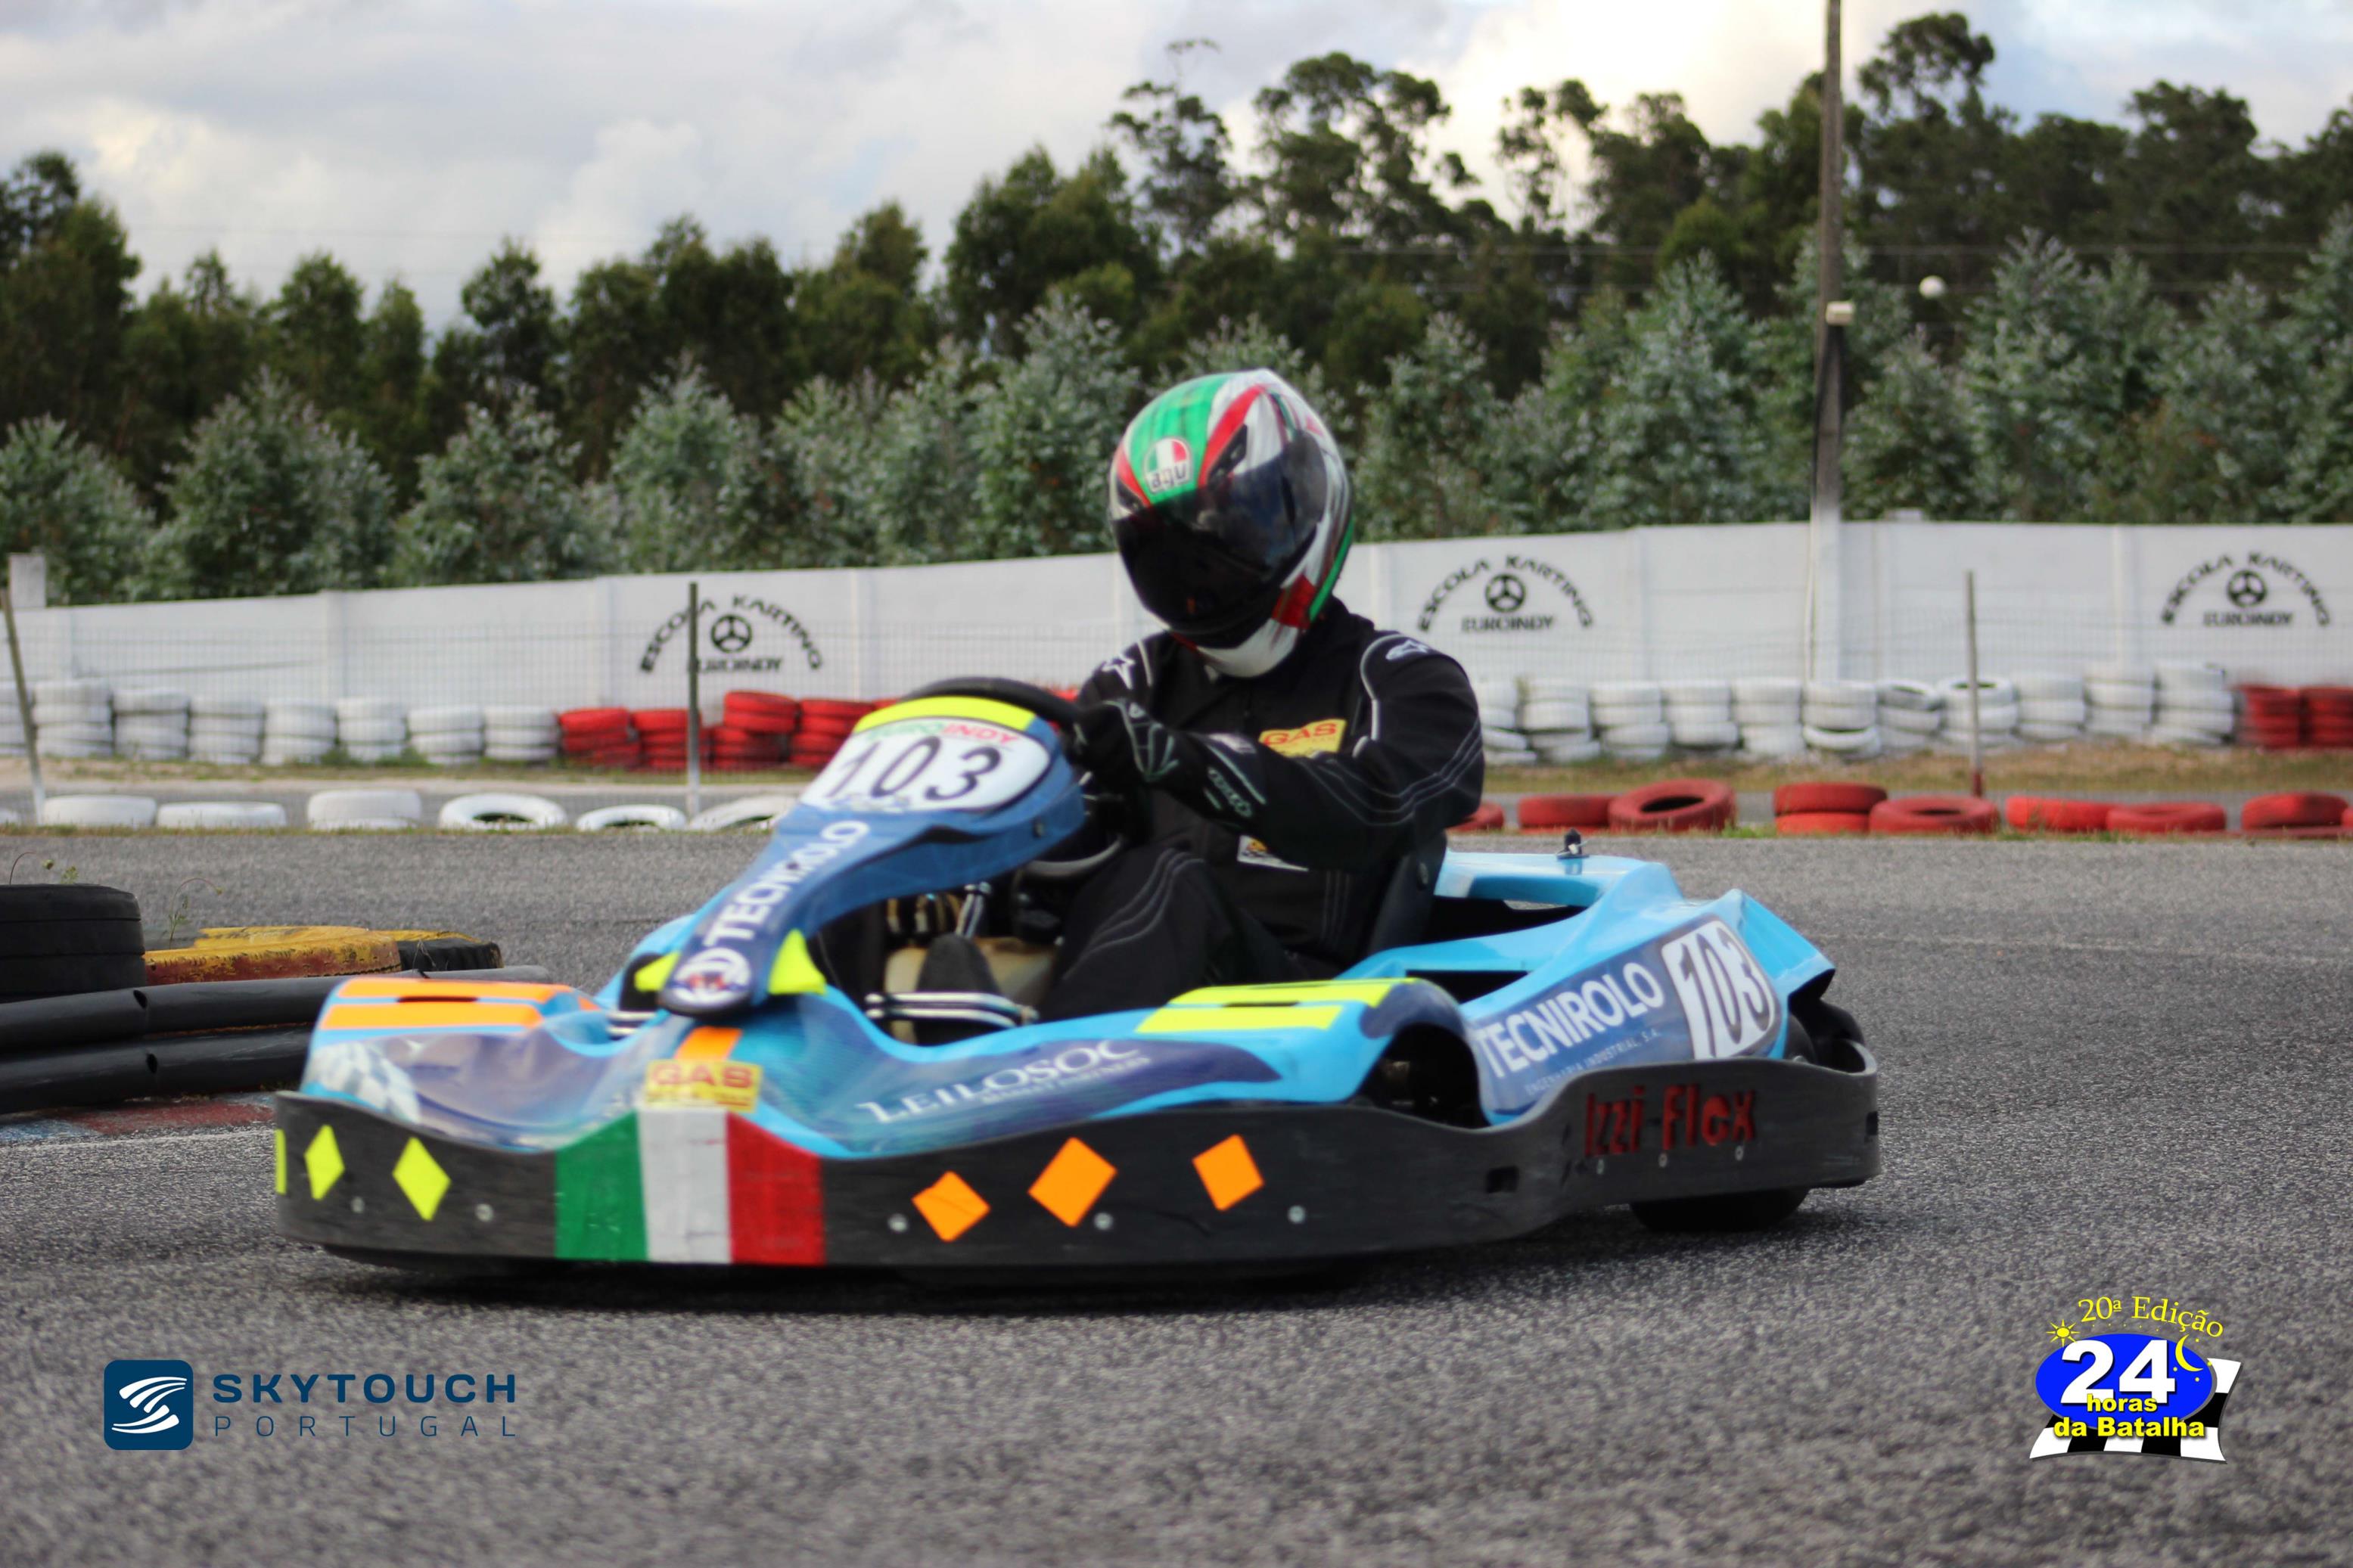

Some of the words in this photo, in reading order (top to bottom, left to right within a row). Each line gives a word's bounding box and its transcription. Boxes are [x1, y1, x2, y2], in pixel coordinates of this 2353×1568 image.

[1419, 559, 1490, 632] ESCOLA
[1506, 554, 1593, 627] KARTING
[1462, 615, 1553, 632] EUROINDY
[2162, 554, 2233, 624] ESCOLA
[2248, 551, 2330, 626] KARTING
[690, 656, 782, 672] UROINDY
[733, 593, 822, 670] KARTING
[826, 736, 1001, 800] 103
[1264, 723, 1338, 747] GAS
[1475, 961, 1665, 1079] TECNIROLO
[1680, 927, 1770, 1059] 103
[652, 1063, 753, 1089] GAS
[856, 1039, 1139, 1124] LEILOSOC
